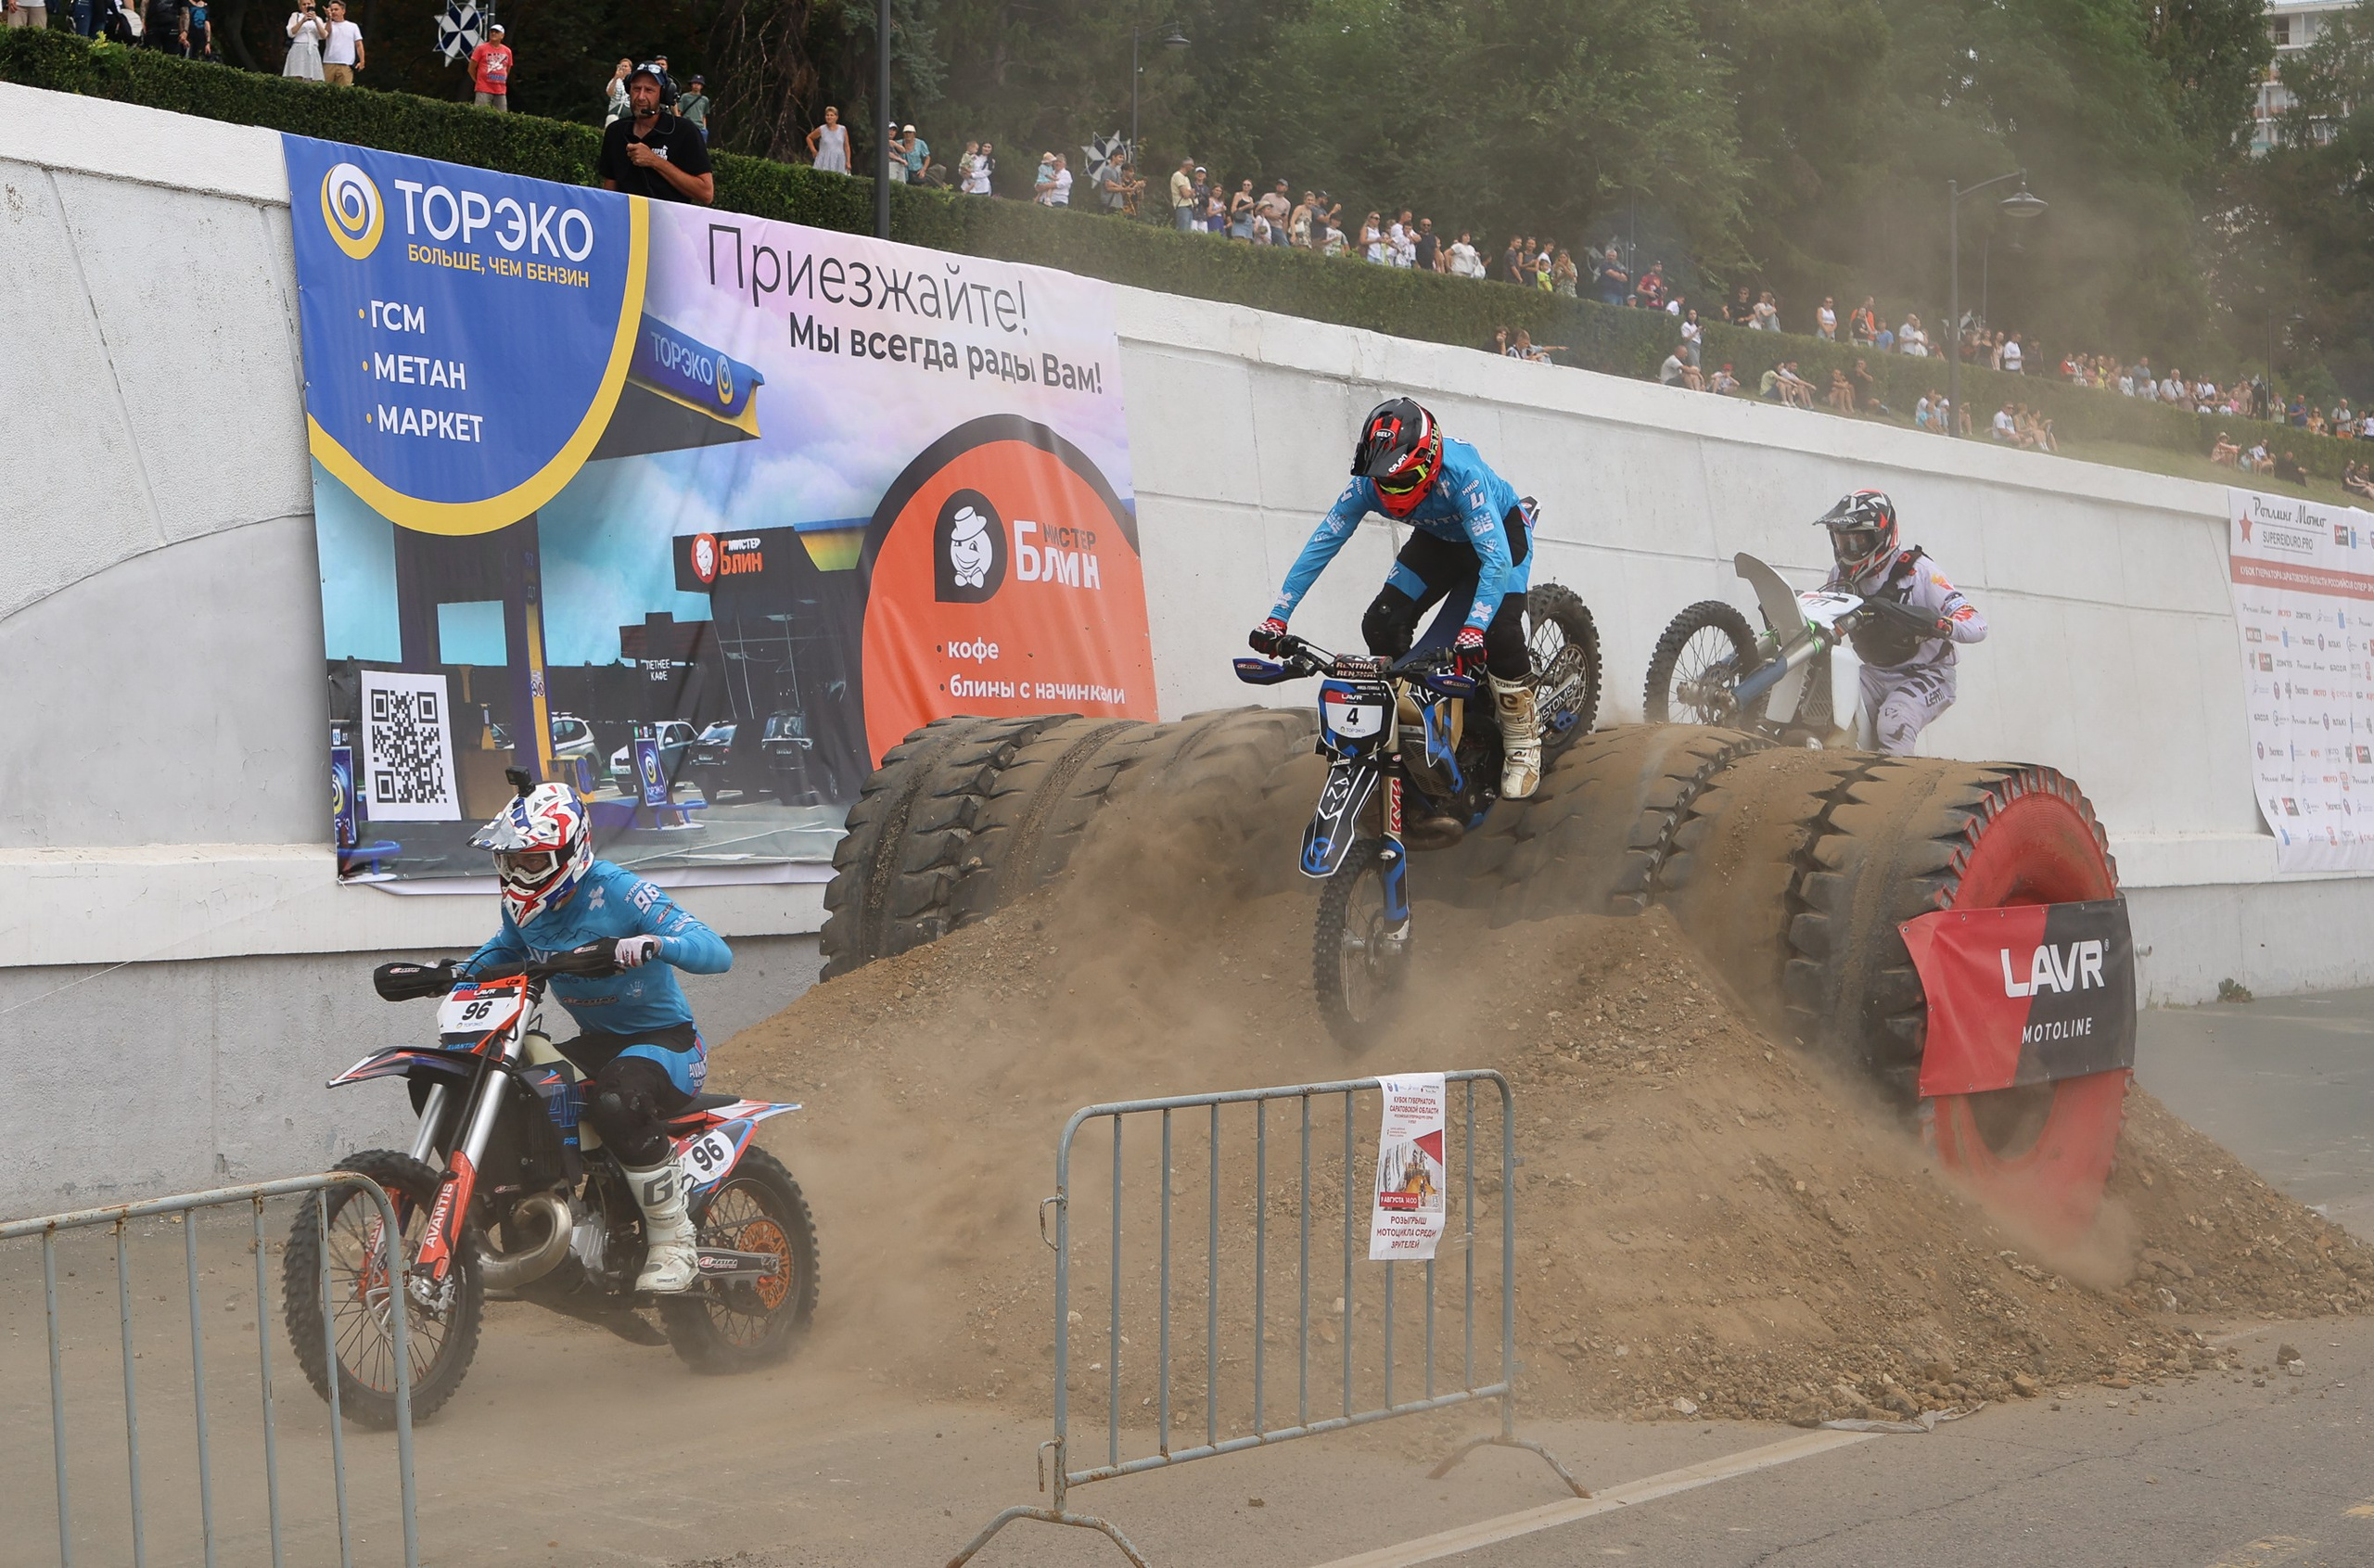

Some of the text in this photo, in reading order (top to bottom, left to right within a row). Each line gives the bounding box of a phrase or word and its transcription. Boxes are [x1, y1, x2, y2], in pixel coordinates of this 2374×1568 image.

[394, 179, 594, 262] ТОРЭКО
[407, 243, 590, 288] БОЛЬШЕ, ЧЕМ БЕНЗИН
[708, 223, 1027, 337] Приезжайте!
[370, 300, 426, 334] ГСМ
[650, 332, 713, 386] ТОРЭКО
[789, 312, 1104, 394] Мы всегда рады Вам!
[374, 351, 467, 390] МЕТАН
[377, 403, 484, 443] МАРКЕТ
[1042, 522, 1097, 551] МИСТЕР
[947, 636, 1000, 664] кофе
[1336, 661, 1379, 671] RENTHAL
[950, 673, 1127, 705] блины с начинками
[1341, 693, 1363, 702] LAVR
[1347, 708, 1359, 726] 4
[2000, 939, 2106, 999] LAVR
[473, 988, 497, 996] LAVR
[462, 1001, 493, 1022] 96
[2022, 1017, 2093, 1045] MOTOLINE
[1389, 1104, 1419, 1114] САРАТОВСКОЙ
[691, 1137, 725, 1172] 96
[425, 1182, 453, 1249] AVANTIS
[1390, 1216, 1427, 1225] РОЗЫГРЫШ
[1376, 1228, 1437, 1239] МОТОЦИКЛА СРЕДИ
[1391, 1240, 1420, 1249] ЗРИТЕЛЕЙ
